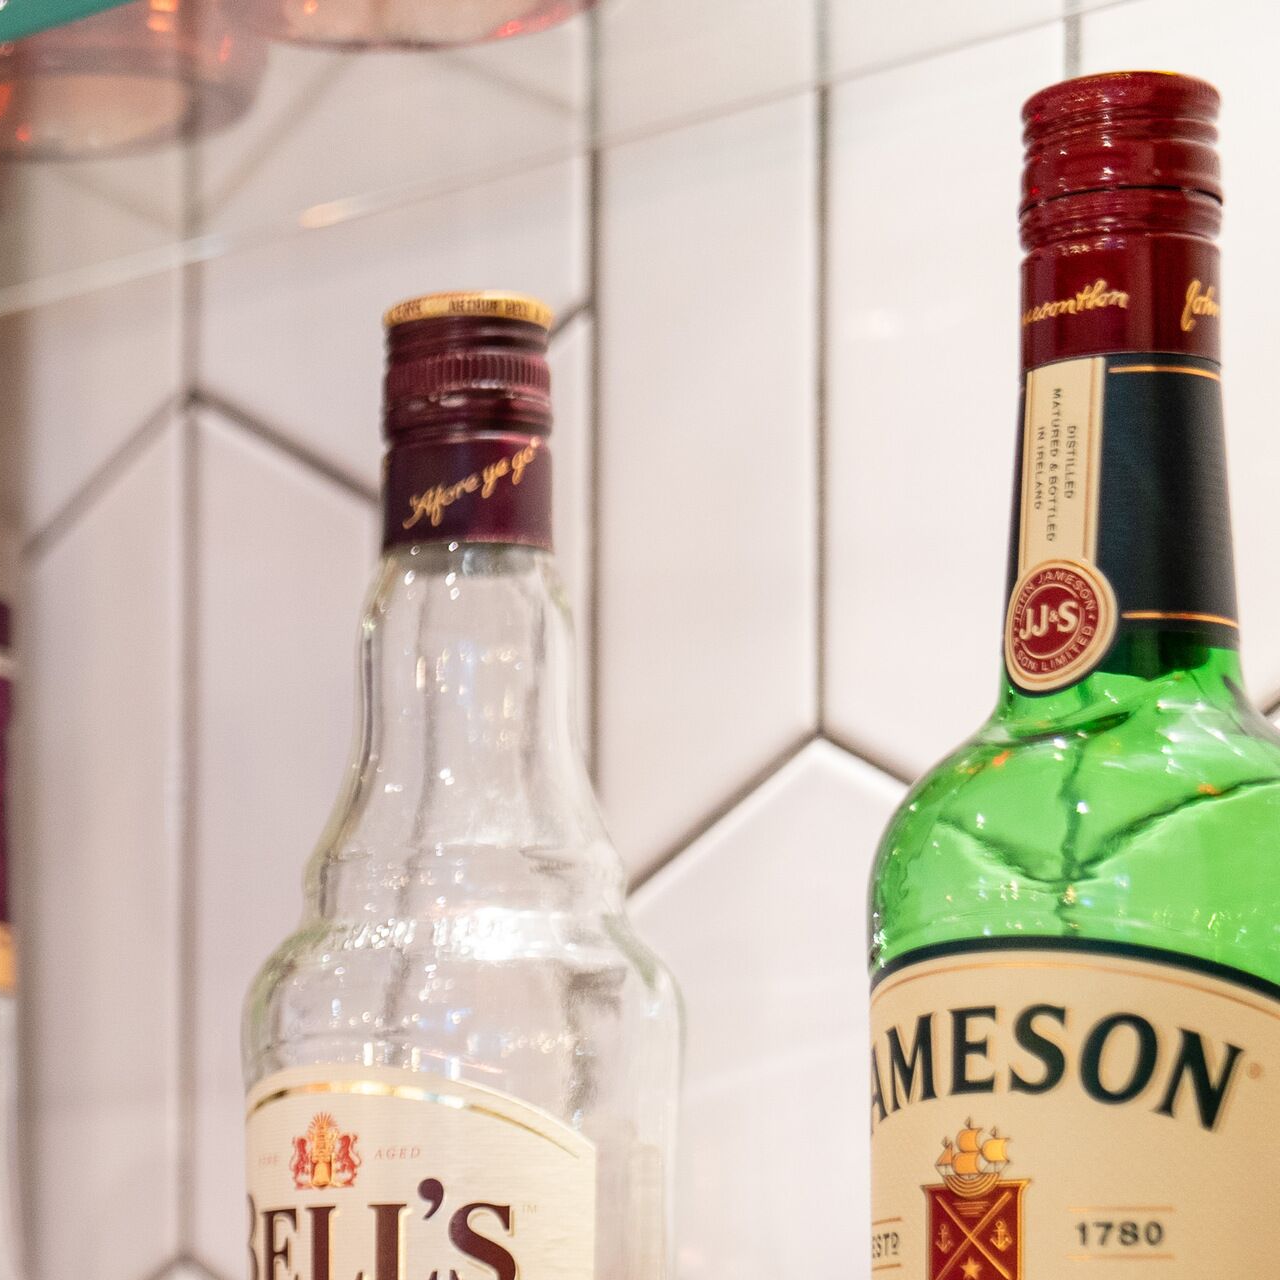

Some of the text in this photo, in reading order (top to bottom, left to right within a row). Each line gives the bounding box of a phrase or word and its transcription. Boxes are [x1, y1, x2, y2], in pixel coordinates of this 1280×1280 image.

[1034, 426, 1045, 510] IN IRELAND
[1046, 387, 1062, 542] MATURED & BOTTLED
[1063, 425, 1077, 499] DISTILLED
[402, 472, 482, 530] Afore
[481, 457, 510, 499] ye
[1019, 600, 1079, 640] JJ&S
[1038, 571, 1097, 611] JAMESON
[1041, 625, 1095, 671] LIMITED
[871, 1003, 1244, 1134] AMESON
[375, 1148, 421, 1160] AGED
[1075, 1220, 1164, 1246] 1780
